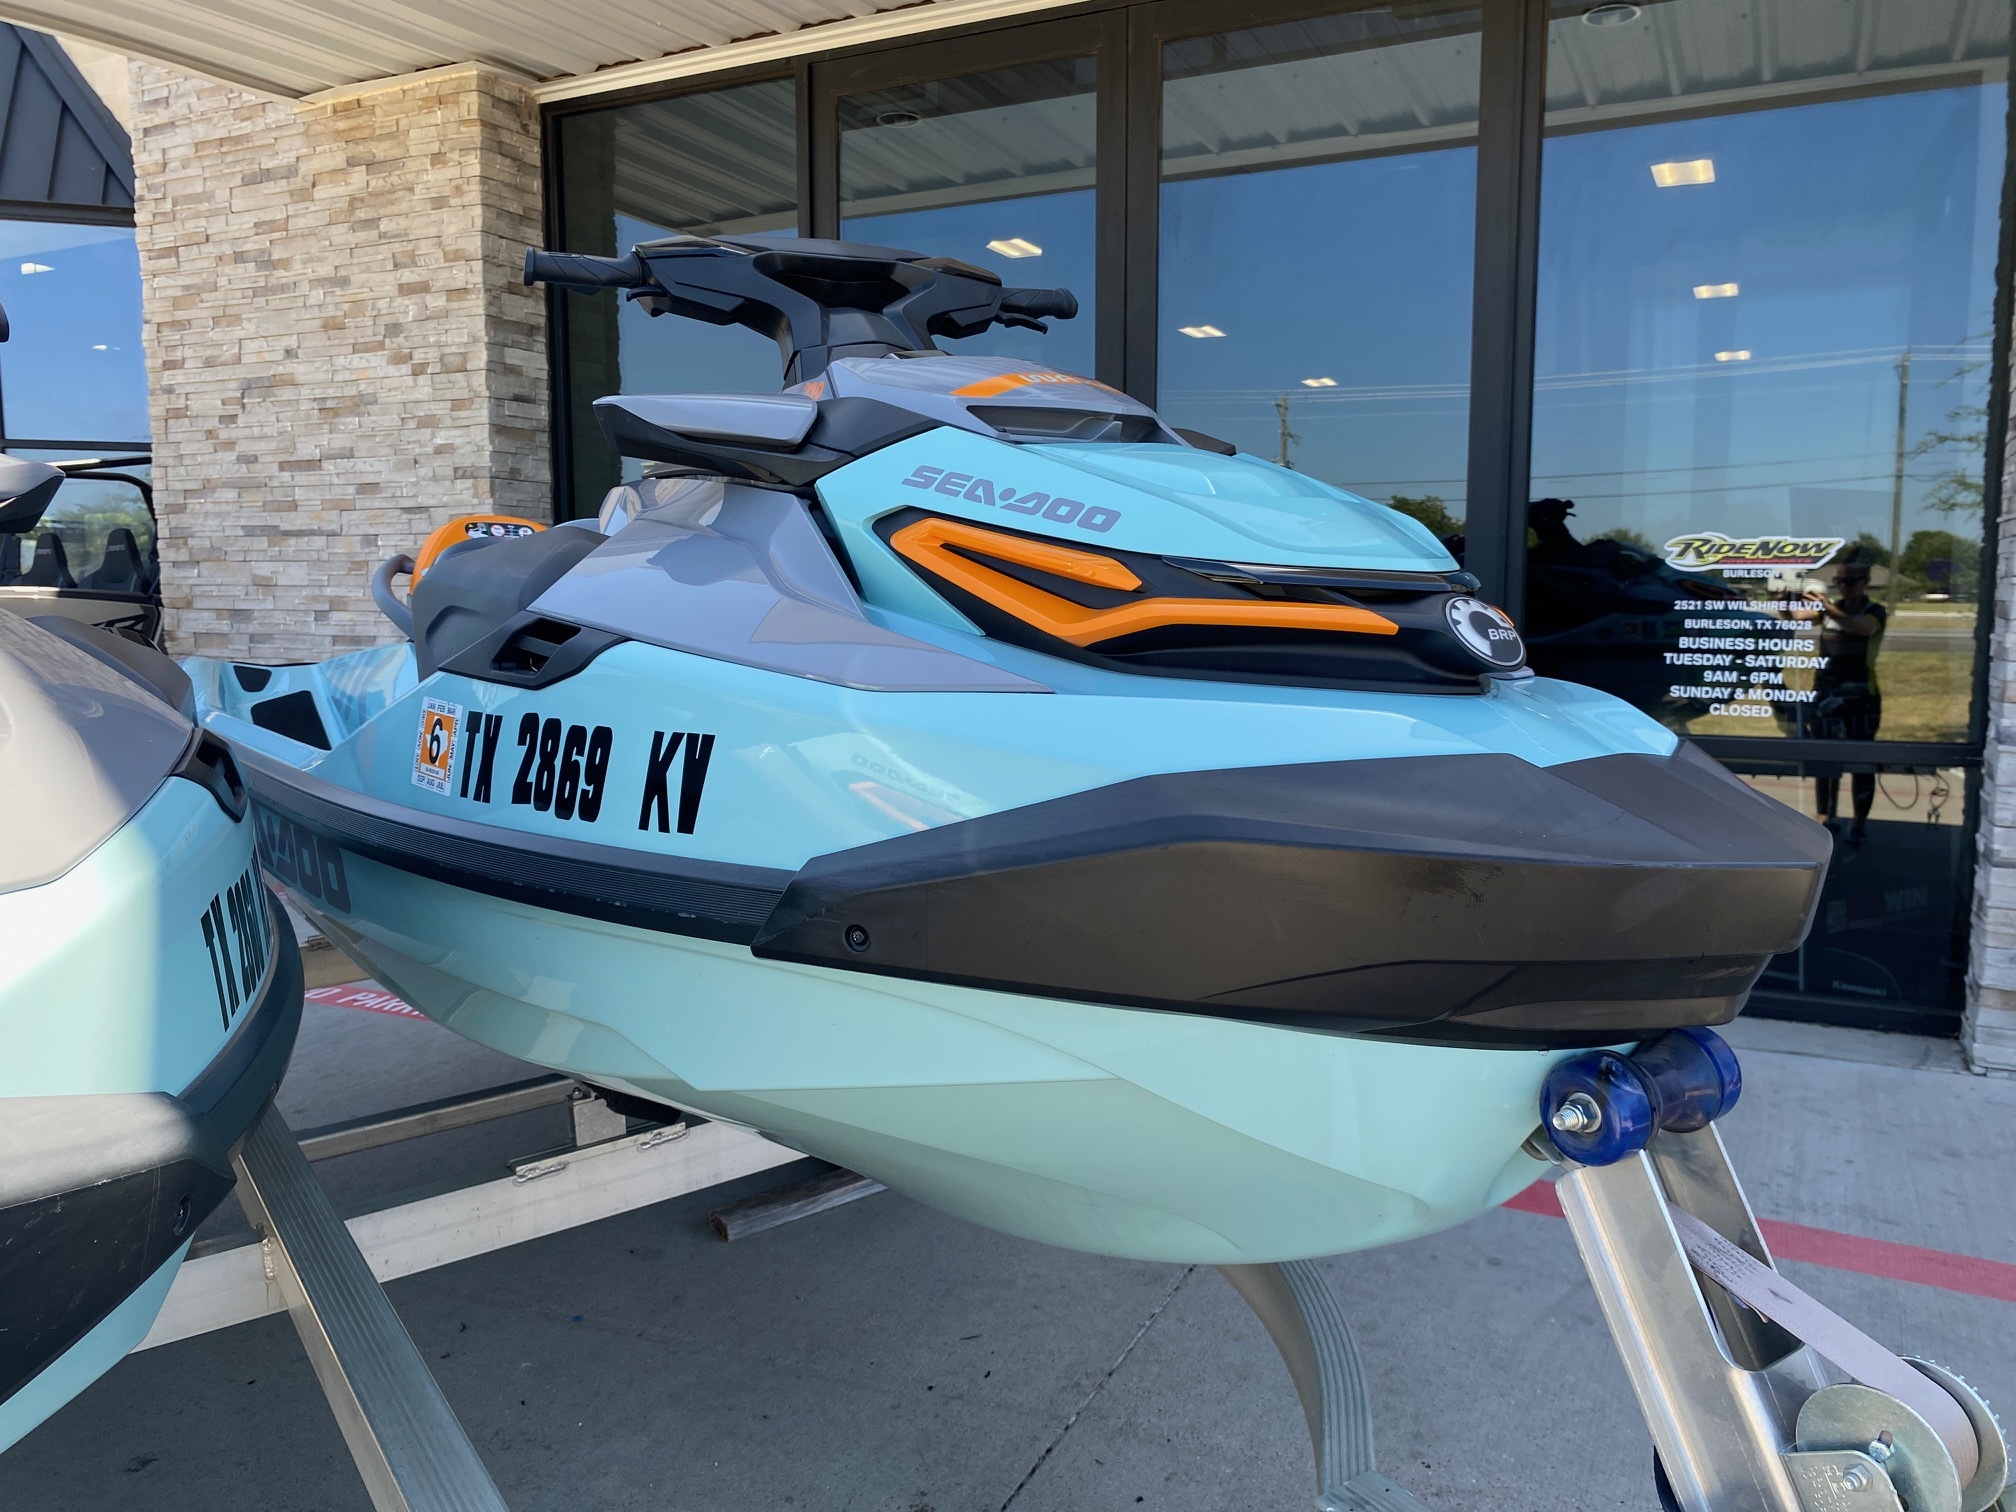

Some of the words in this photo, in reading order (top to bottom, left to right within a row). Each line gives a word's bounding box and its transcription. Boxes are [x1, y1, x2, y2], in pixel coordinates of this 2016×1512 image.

[1723, 569, 1780, 578] BURLESON
[1674, 600, 1701, 610] 2521
[1705, 600, 1726, 611] SW
[1727, 600, 1789, 611] WILSHIRE
[1789, 601, 1826, 611] BLVD.
[1684, 618, 1753, 630] BURLESON,
[1755, 619, 1773, 630] TX
[1774, 620, 1812, 631] 76028
[1488, 628, 1516, 640] BRP
[1679, 637, 1755, 650] BUSINESS
[1758, 638, 1815, 651] HOURS
[1663, 652, 1734, 666] TUESDAY
[1745, 654, 1829, 669] SATURDAY
[1703, 670, 1737, 683] 9AM
[1750, 671, 1783, 684] 6PM
[1670, 685, 1732, 699] SUNDAY
[1734, 686, 1745, 699] &
[1748, 688, 1817, 702] MONDAY
[1709, 703, 1773, 717] CLOSED
[429, 718, 443, 764] 6
[460, 710, 503, 803] TX
[511, 712, 613, 823] 2869
[638, 730, 716, 835] KV
[200, 893, 240, 1033] TX
[304, 987, 342, 999] O
